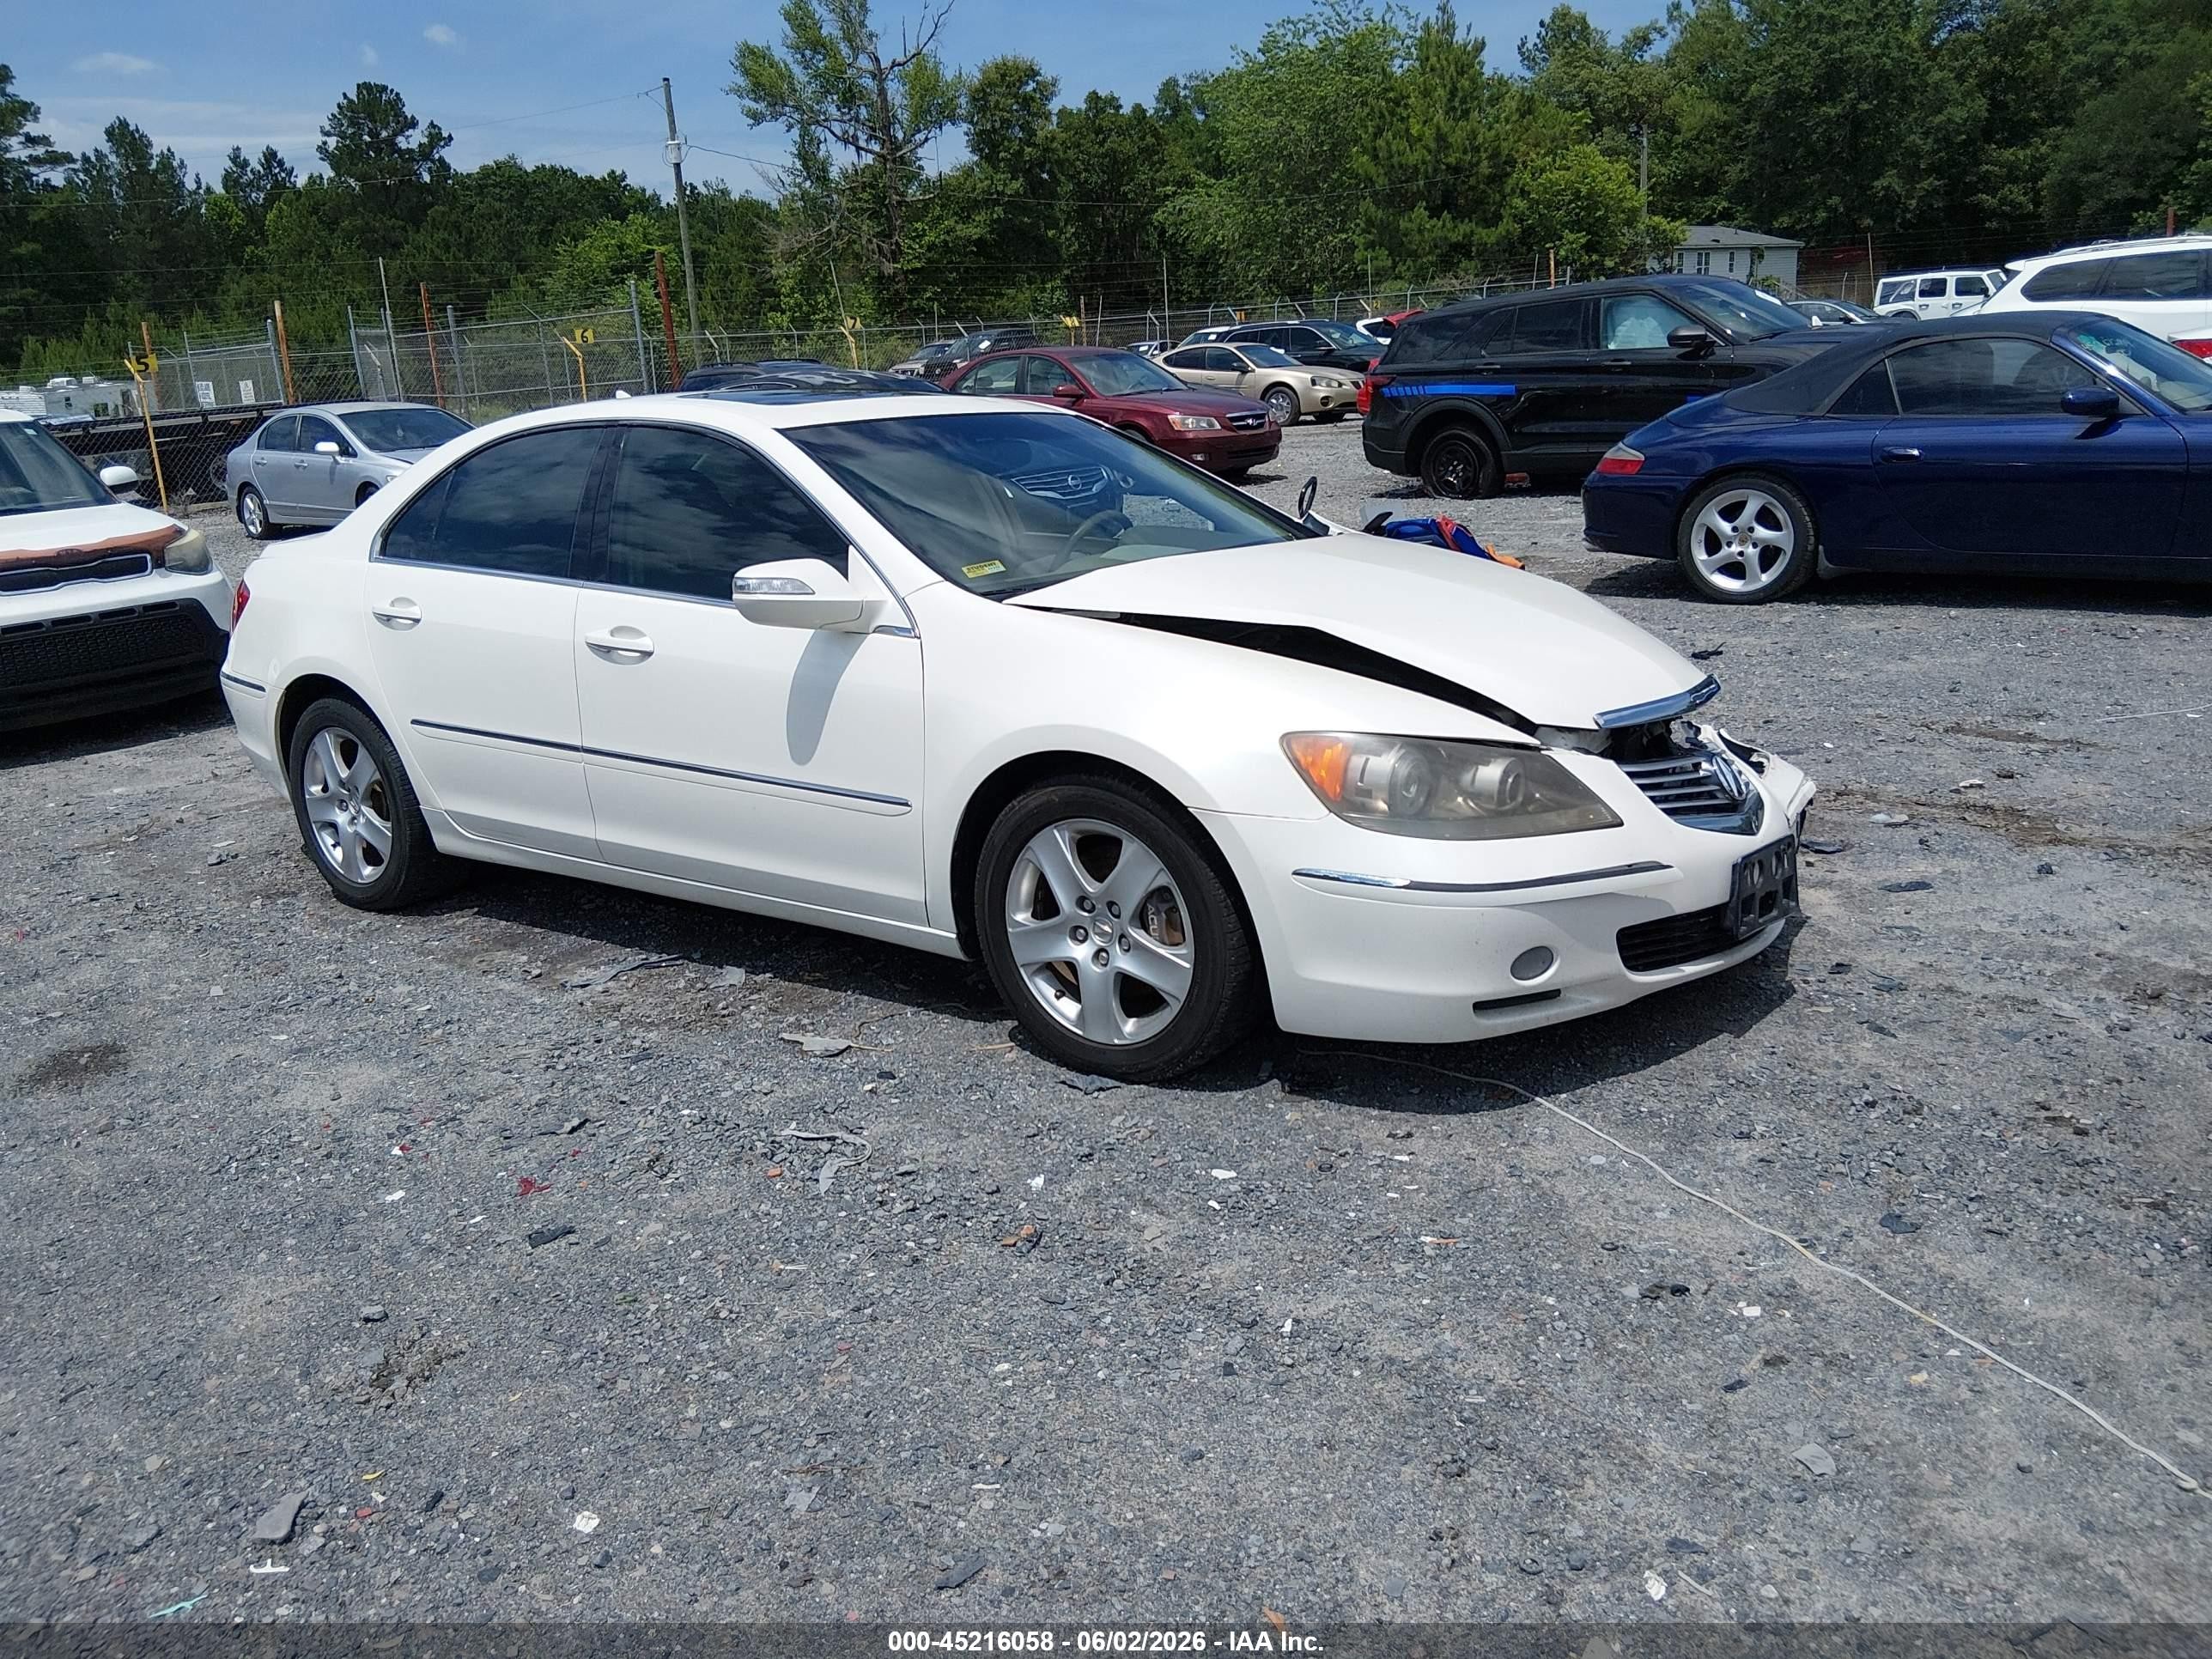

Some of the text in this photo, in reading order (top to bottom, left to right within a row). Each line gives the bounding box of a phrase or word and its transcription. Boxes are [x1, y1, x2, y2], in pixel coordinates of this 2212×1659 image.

[850, 316, 857, 329] 7
[580, 329, 589, 343] 6
[135, 356, 149, 372] 5
